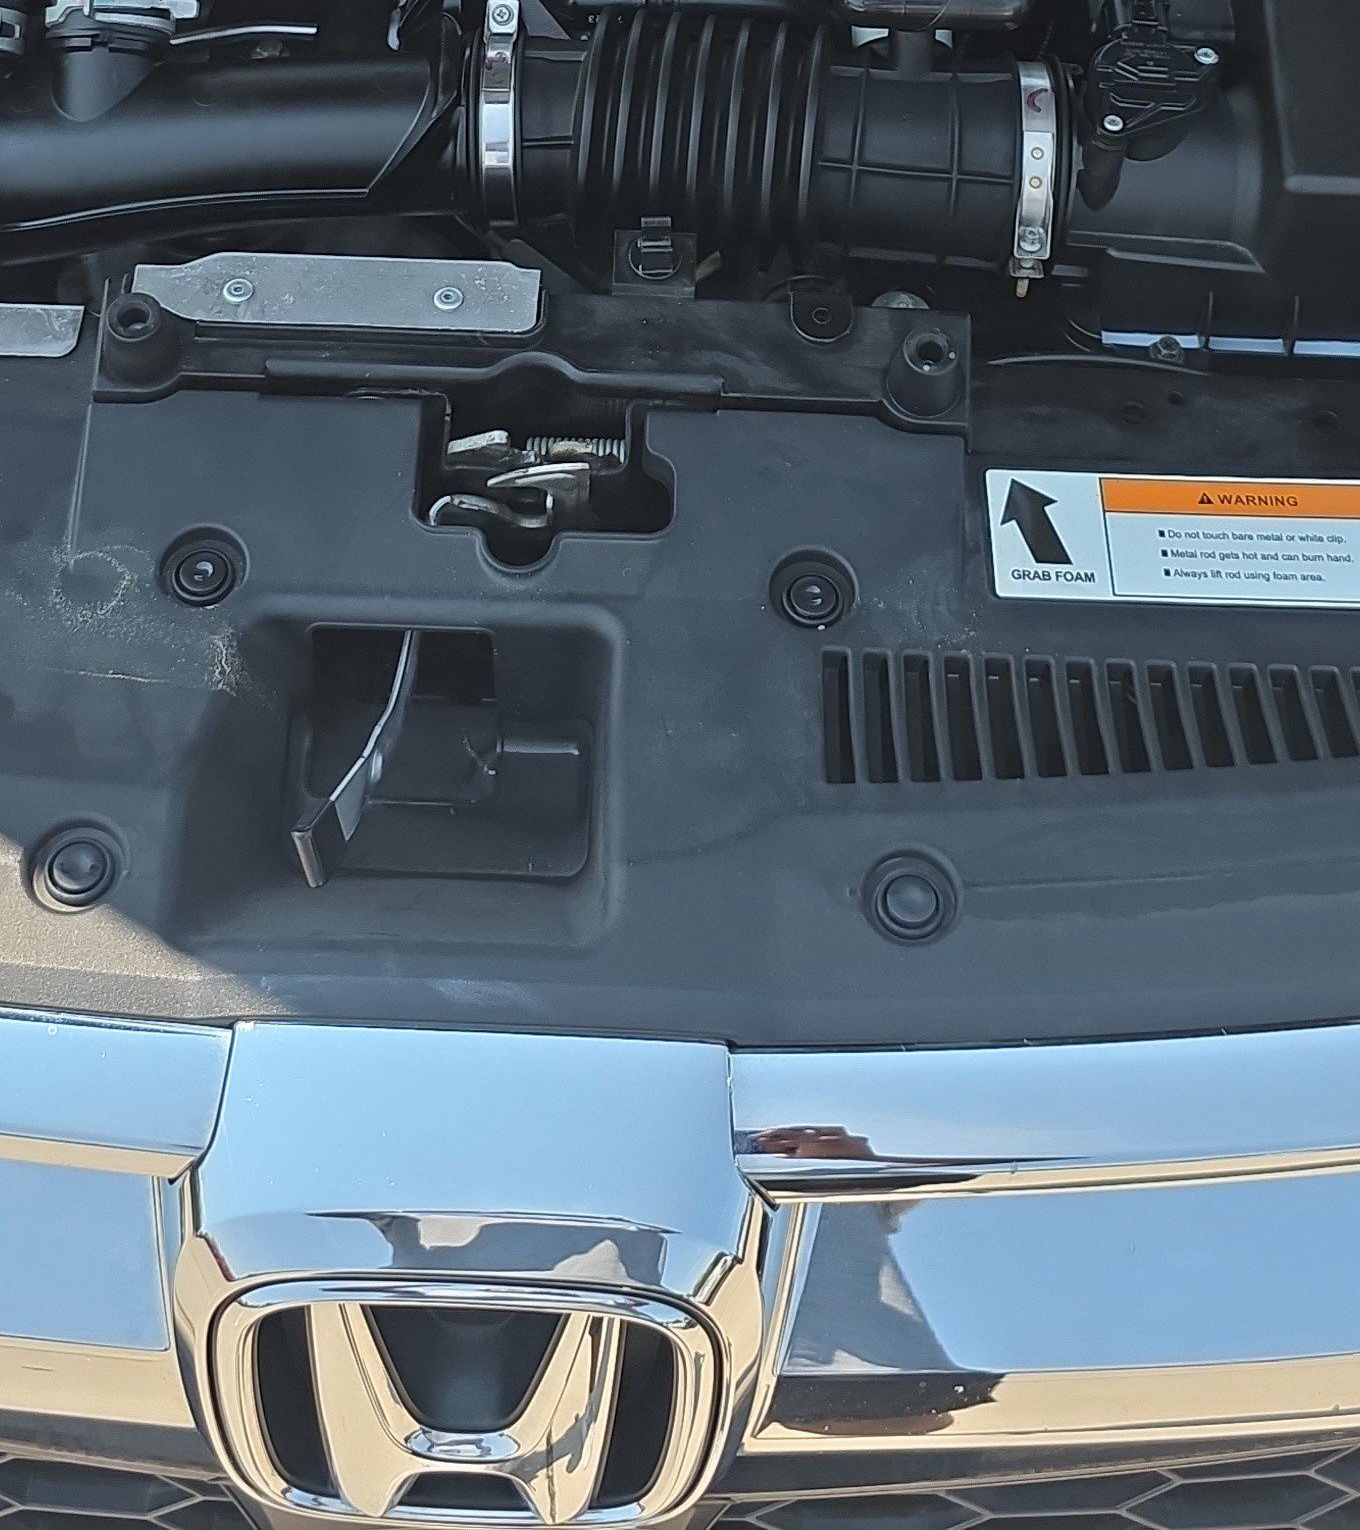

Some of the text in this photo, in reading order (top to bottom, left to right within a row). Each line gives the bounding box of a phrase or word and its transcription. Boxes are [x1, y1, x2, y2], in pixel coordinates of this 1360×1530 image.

[1217, 494, 1299, 507] WARNING
[1167, 530, 1182, 539] Do
[1184, 531, 1200, 539] not
[1202, 531, 1229, 540] touch
[1232, 531, 1254, 541] bare
[1256, 533, 1283, 541] metal
[1298, 534, 1324, 543] white
[1326, 534, 1347, 544] clip.
[1170, 549, 1354, 563] Metal rod gets hot and can burn hand.
[1011, 568, 1096, 583] GRAB FOAM
[1173, 568, 1326, 582] Always lift rod using foam area.
